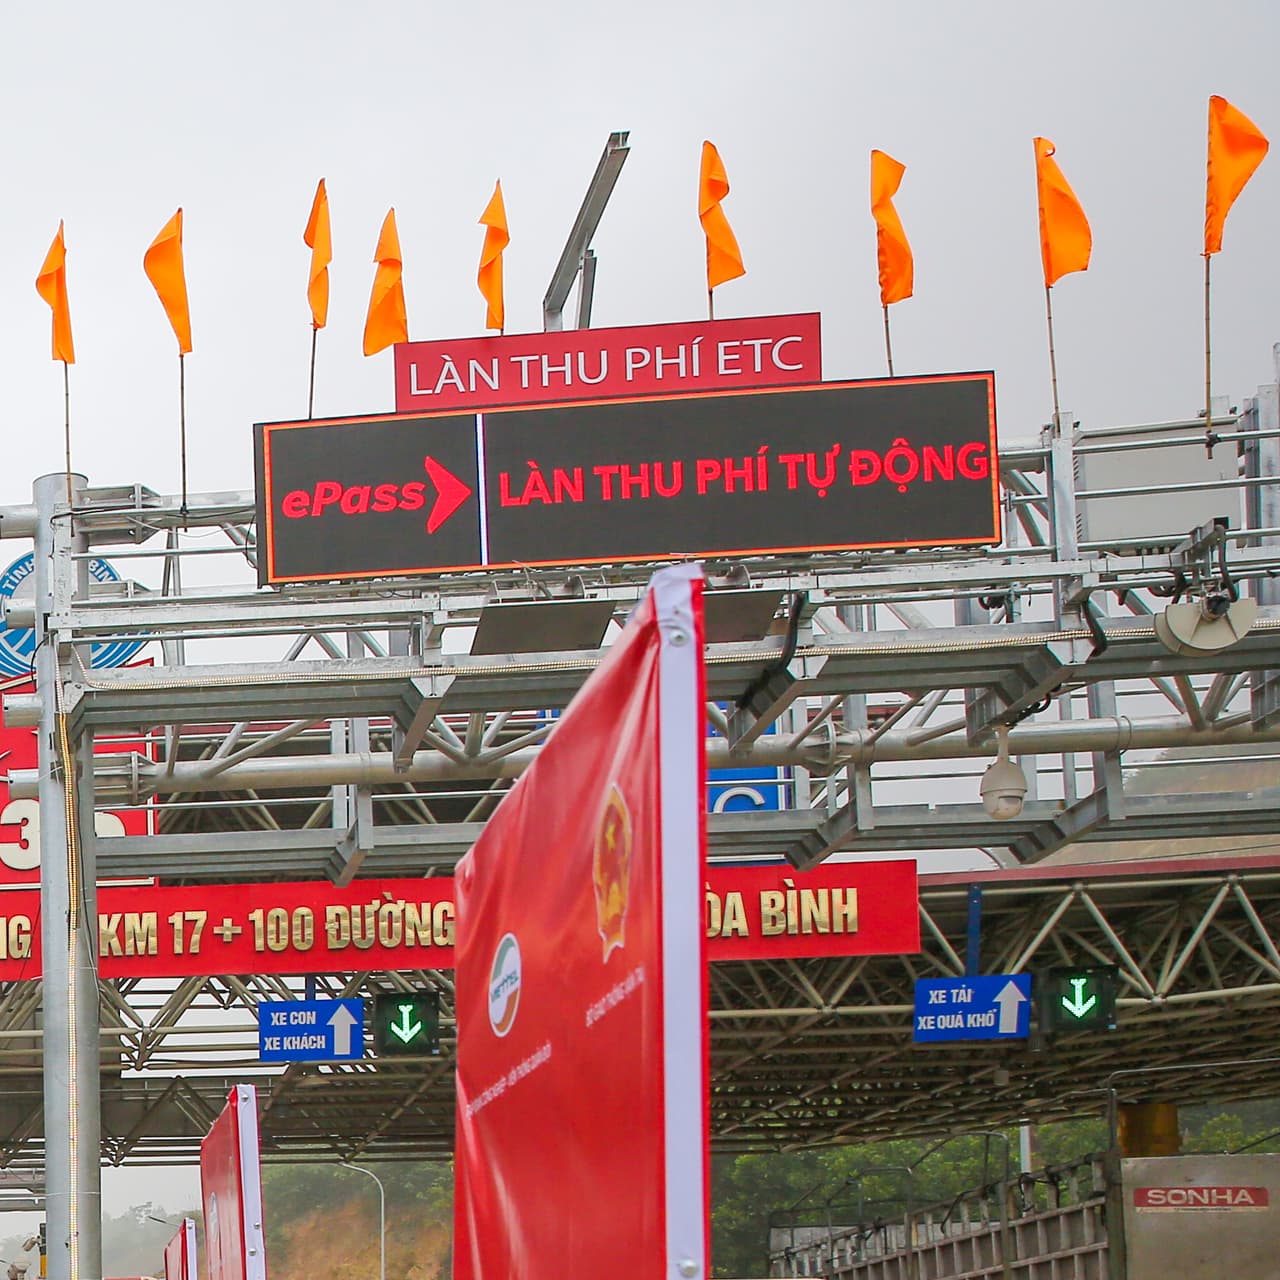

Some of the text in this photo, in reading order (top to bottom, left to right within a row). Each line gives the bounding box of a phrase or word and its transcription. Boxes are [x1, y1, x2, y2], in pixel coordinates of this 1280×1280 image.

[409, 335, 804, 396] LÀN THU PHÍ ETC
[498, 438, 989, 508] LÀN THU PHÍ TỰ ĐỘNG
[281, 480, 427, 520] ePass
[98, 911, 158, 958] KM
[167, 910, 208, 955] 17
[248, 907, 314, 952] 100
[325, 891, 455, 950] ĐƯỜNG
[760, 878, 859, 937] BÌNH
[928, 984, 972, 1004] XE TẢI
[271, 1011, 317, 1026] XE CON
[917, 1016, 936, 1030] XE
[937, 1010, 965, 1029] QUÁ
[264, 1032, 326, 1051] XE KHÁCH
[1147, 1188, 1255, 1205] SONHA
